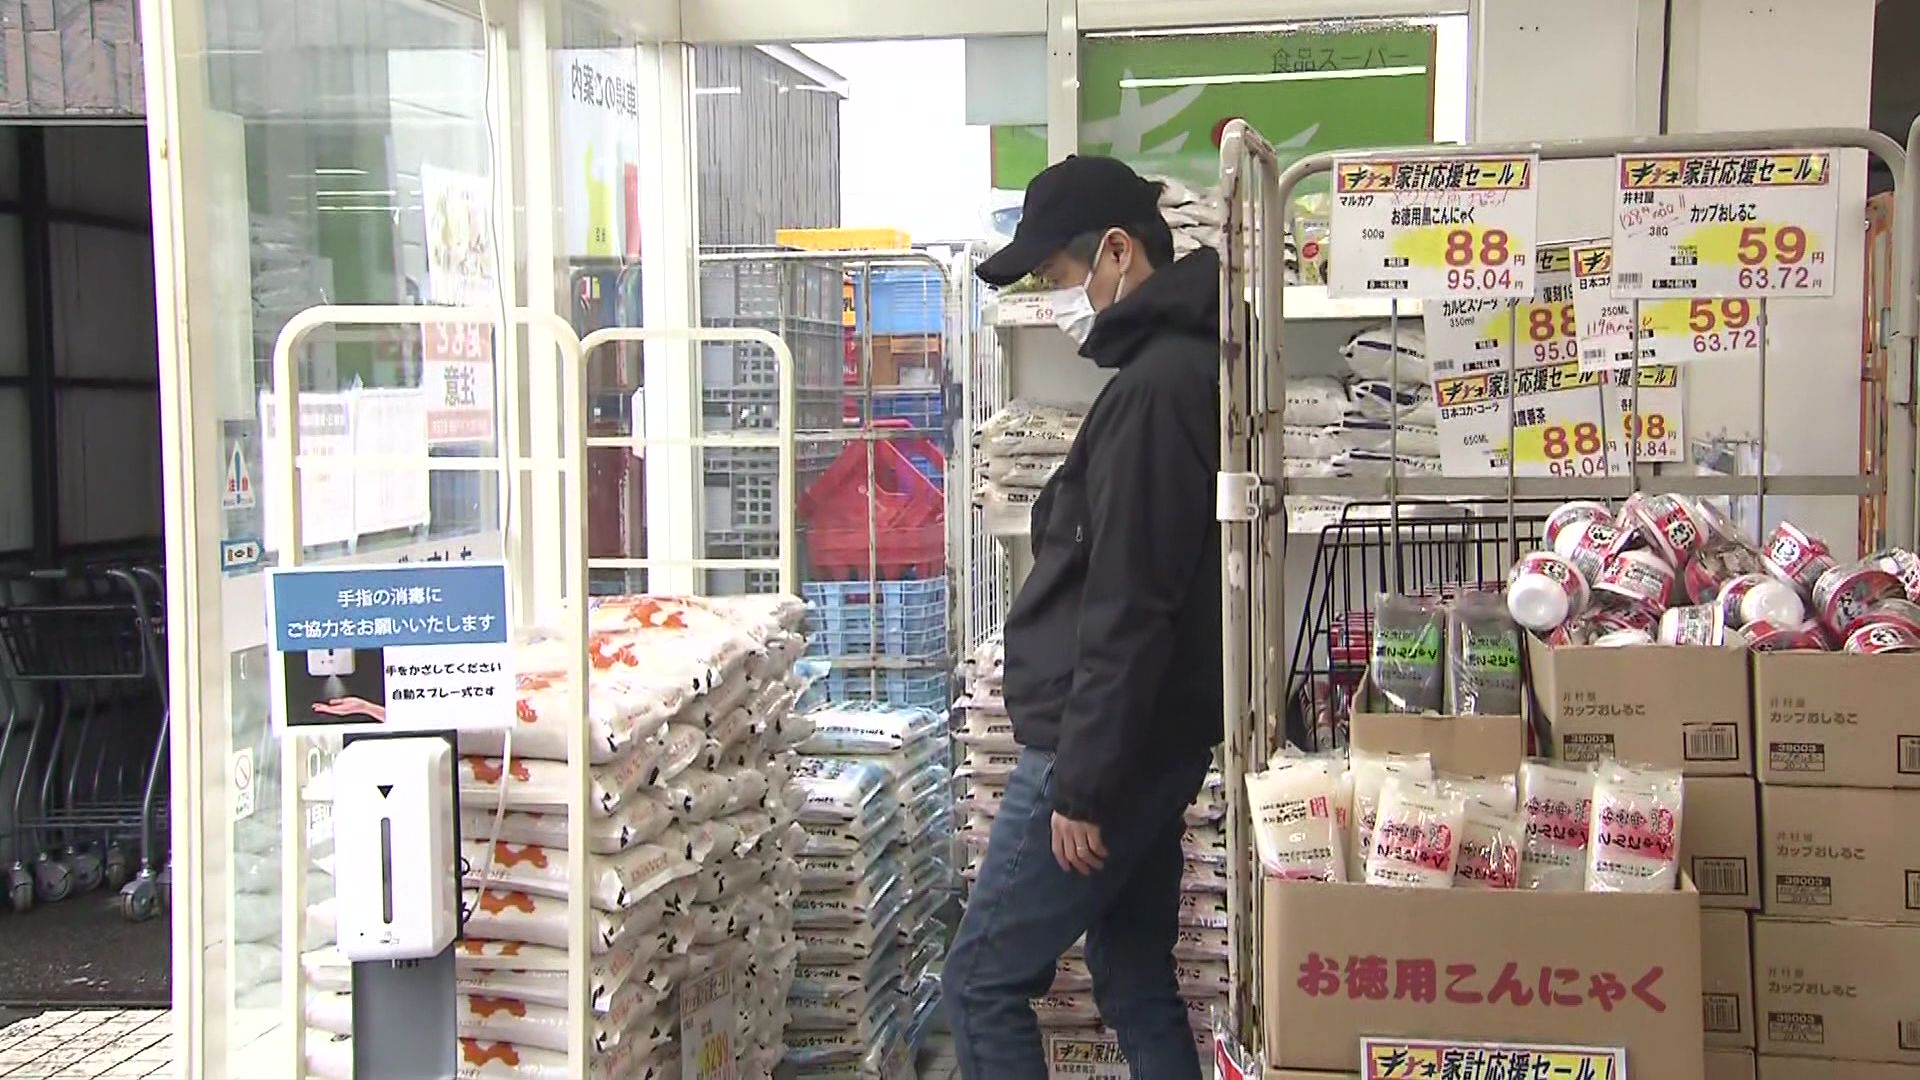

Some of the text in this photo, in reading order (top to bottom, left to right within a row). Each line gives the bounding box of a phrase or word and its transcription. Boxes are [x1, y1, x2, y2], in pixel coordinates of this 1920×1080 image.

[1272, 46, 1409, 73] 食品スーパー
[1339, 195, 1374, 207] マルカワ
[1623, 191, 1655, 205] 井村屋
[1690, 204, 1757, 223] カップおしるこ
[1362, 228, 1385, 240] 500g
[1445, 229, 1525, 267] 88 円
[1737, 226, 1825, 266] 59 円
[1447, 269, 1511, 291] 95.04
[1739, 268, 1809, 289] 63.72
[1601, 307, 1629, 317] 250ML
[1689, 298, 1750, 333] 59
[1693, 330, 1756, 352] 63.72
[1543, 423, 1600, 459] 88
[337, 587, 442, 608] 手指の消毒に
[287, 614, 496, 639] ご協力をお願いいたします
[385, 663, 502, 678] 手をかざしてください
[392, 686, 496, 701] 自動スプレー式です
[1563, 704, 1646, 716] カップおしるこ
[1770, 712, 1858, 725] カップおしるこ
[1776, 846, 1865, 860] カップおしるこ
[1297, 953, 1667, 1014] お徳用こんにゃく
[1768, 981, 1857, 998] カップおしるこ
